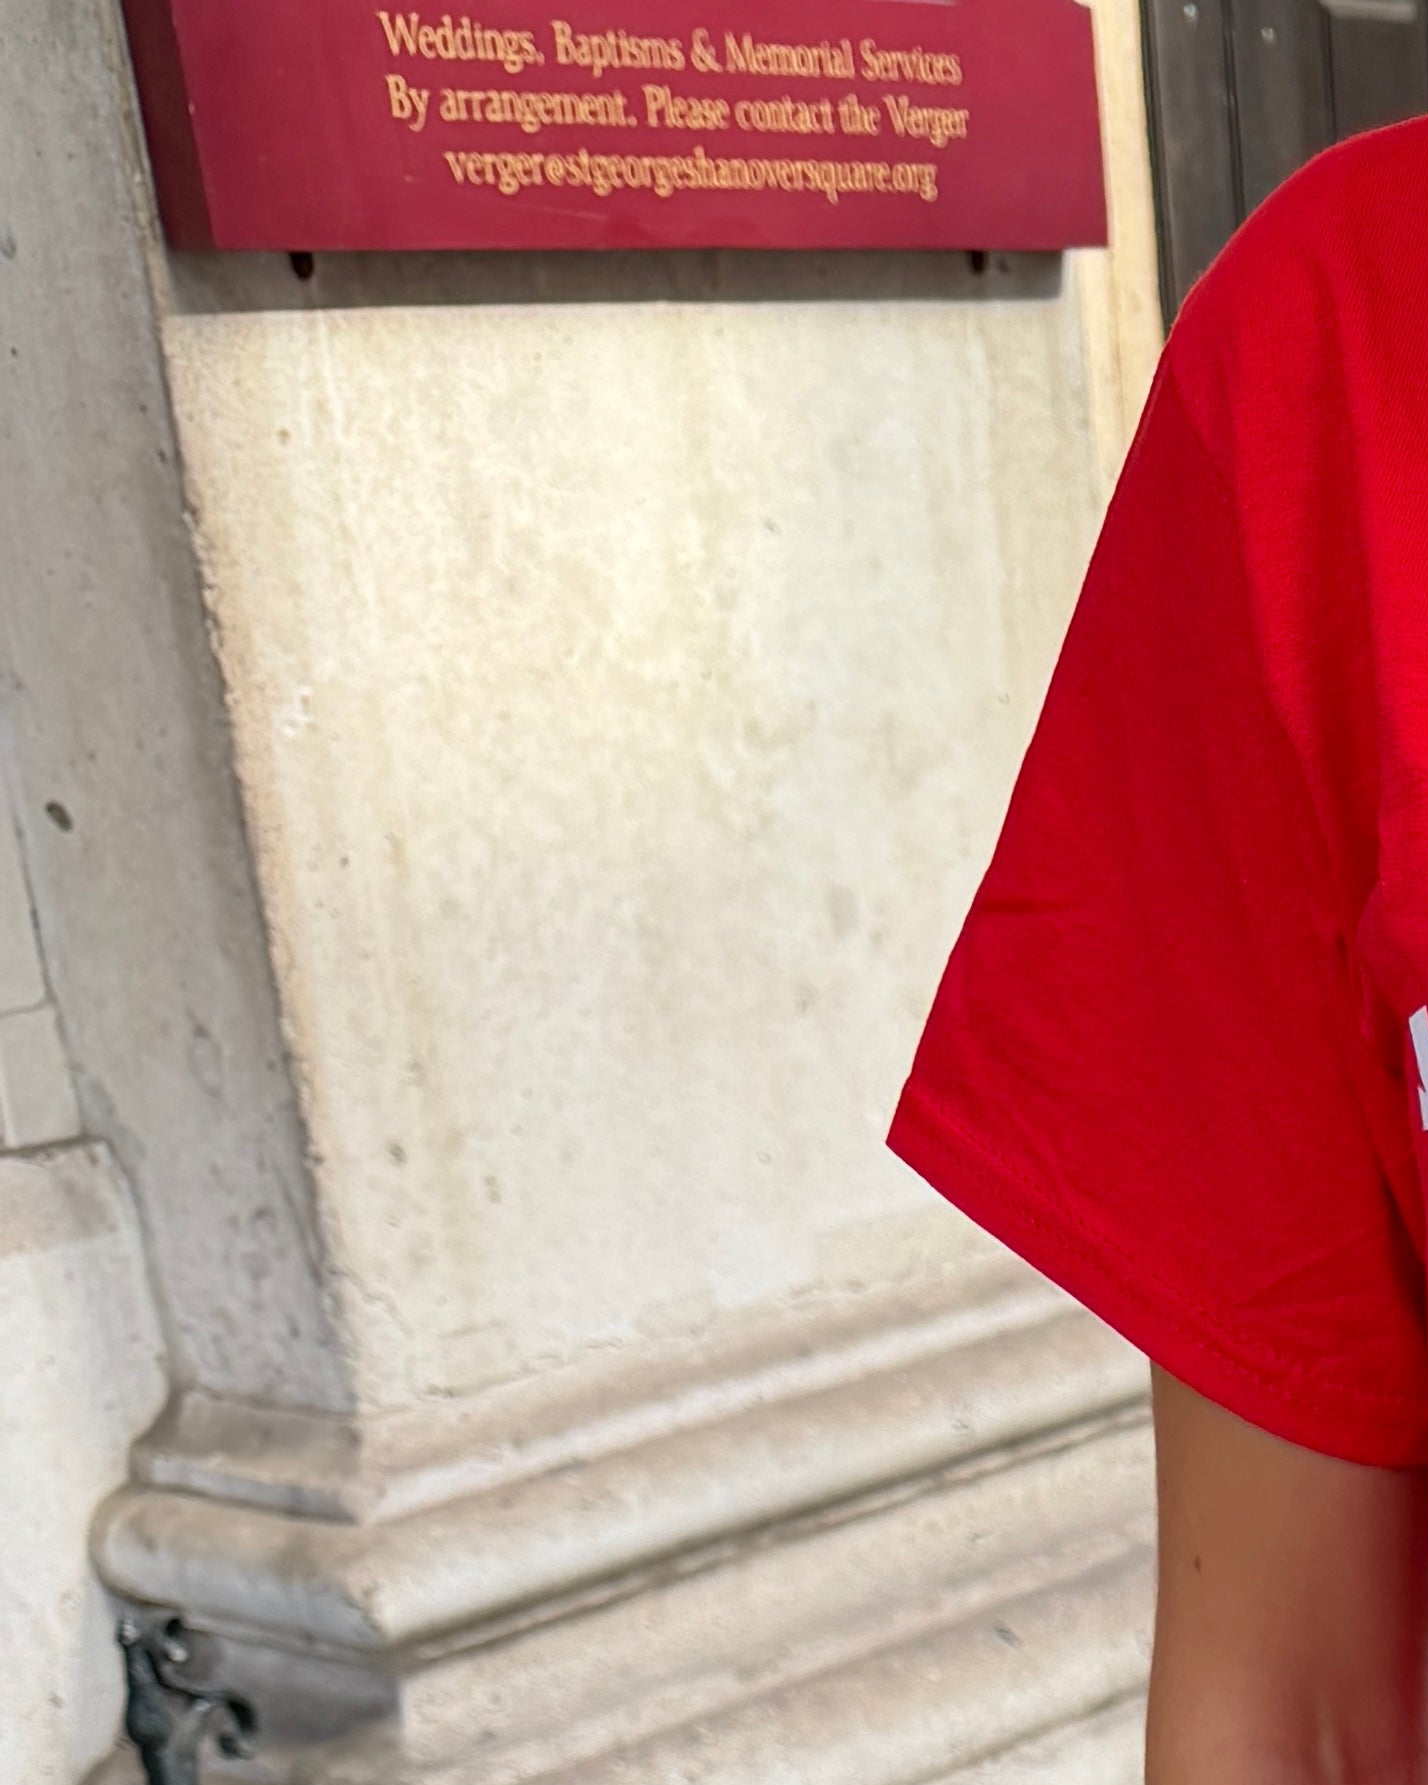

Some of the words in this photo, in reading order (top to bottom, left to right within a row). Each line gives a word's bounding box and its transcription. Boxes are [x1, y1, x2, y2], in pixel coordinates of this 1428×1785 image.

[551, 20, 685, 78] Baptisms
[690, 27, 723, 73] &
[724, 30, 855, 79] Memorial
[859, 38, 963, 85] Services
[385, 74, 429, 132] By
[440, 89, 637, 134] arrangement.
[641, 84, 730, 130] Please
[735, 94, 835, 135] contact
[838, 93, 881, 137] the
[882, 94, 969, 148] Verger
